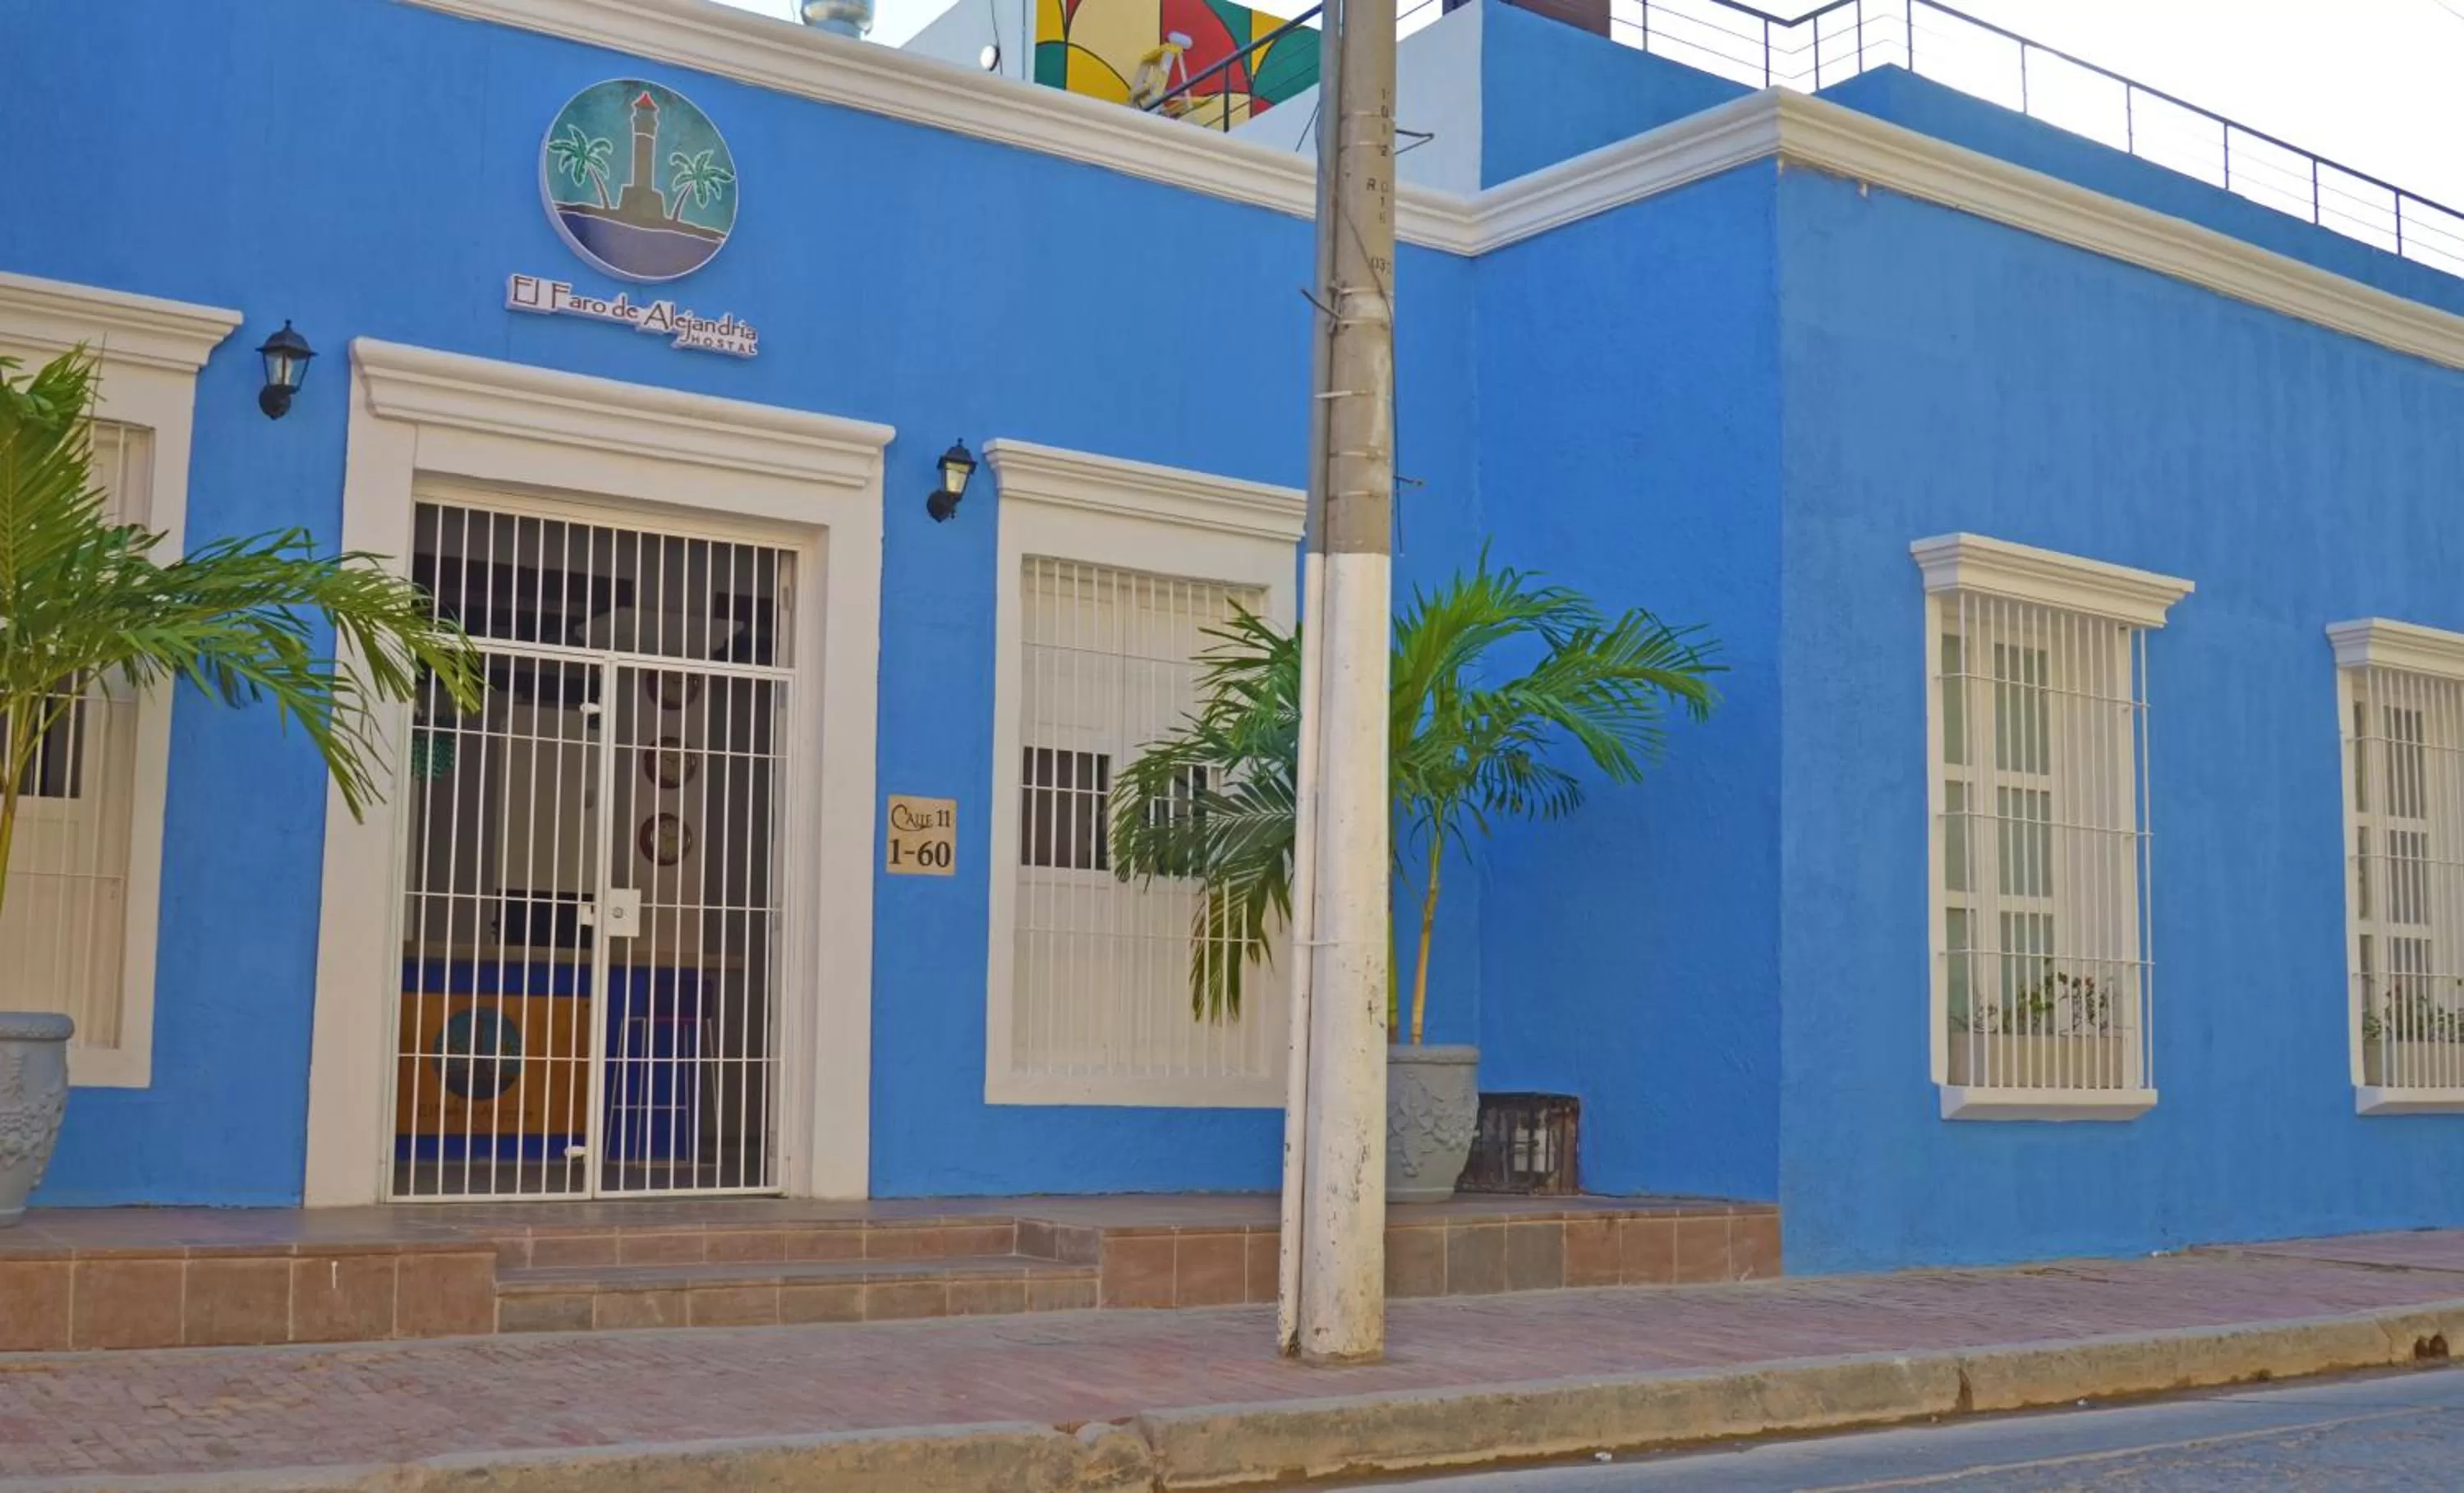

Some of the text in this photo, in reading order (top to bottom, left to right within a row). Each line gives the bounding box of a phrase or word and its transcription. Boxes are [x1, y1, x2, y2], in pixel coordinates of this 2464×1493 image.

[513, 275, 540, 305] El
[551, 283, 606, 314] Faro
[612, 296, 639, 319] de
[691, 334, 756, 354] HOSTAL
[935, 809, 950, 828] 11
[889, 838, 951, 868] 1-60
